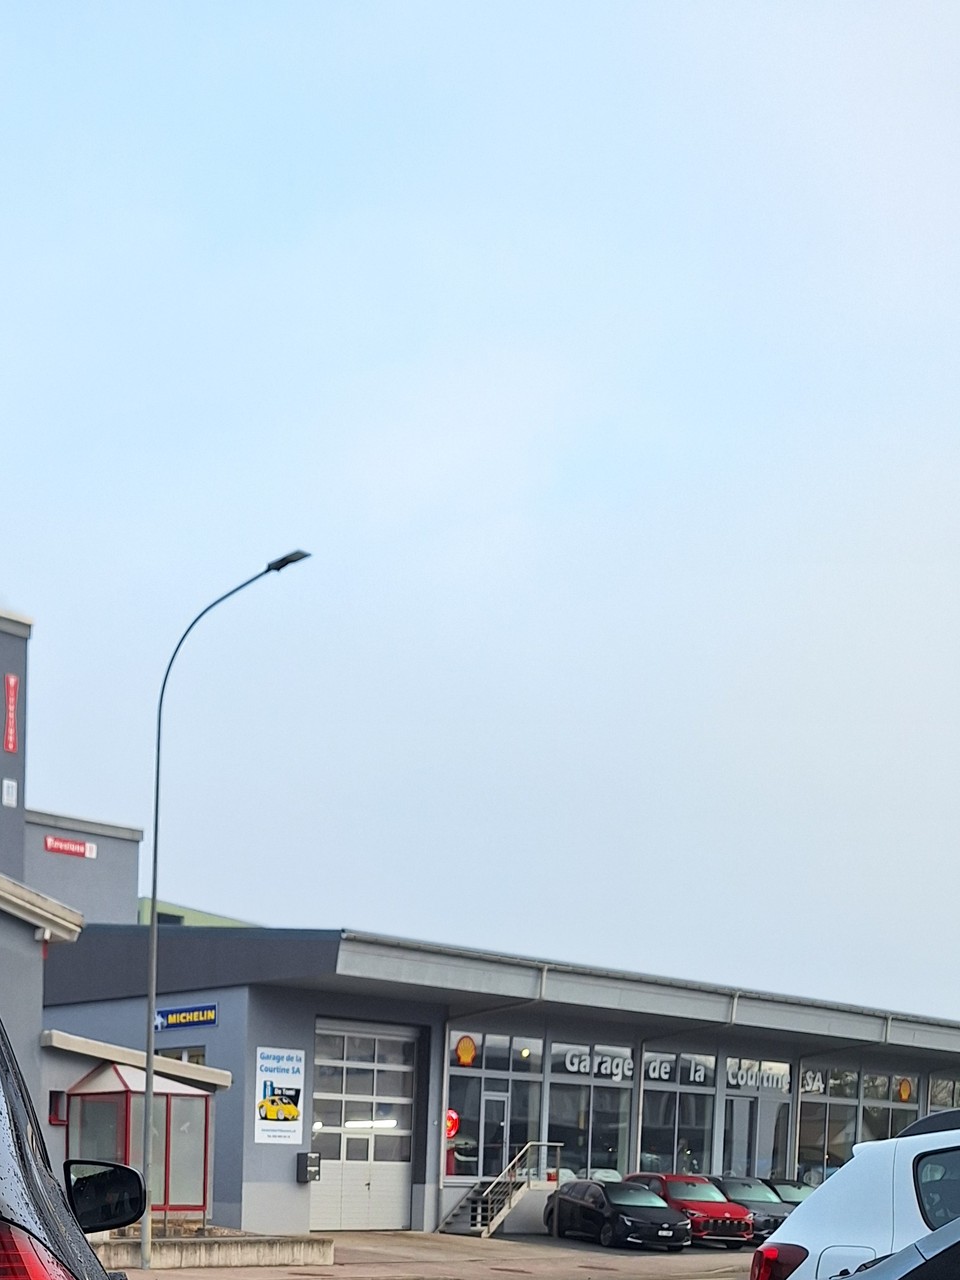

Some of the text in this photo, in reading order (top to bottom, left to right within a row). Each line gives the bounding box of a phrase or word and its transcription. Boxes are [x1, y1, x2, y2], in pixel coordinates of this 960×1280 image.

[167, 1009, 215, 1025] MICHELIN
[260, 1052, 285, 1063] Garage
[286, 1054, 294, 1062] de
[259, 1065, 300, 1074] Courtine SA
[565, 1050, 634, 1082] Garage
[649, 1059, 670, 1080] de
[689, 1060, 705, 1083] la
[805, 1070, 825, 1093] SA
